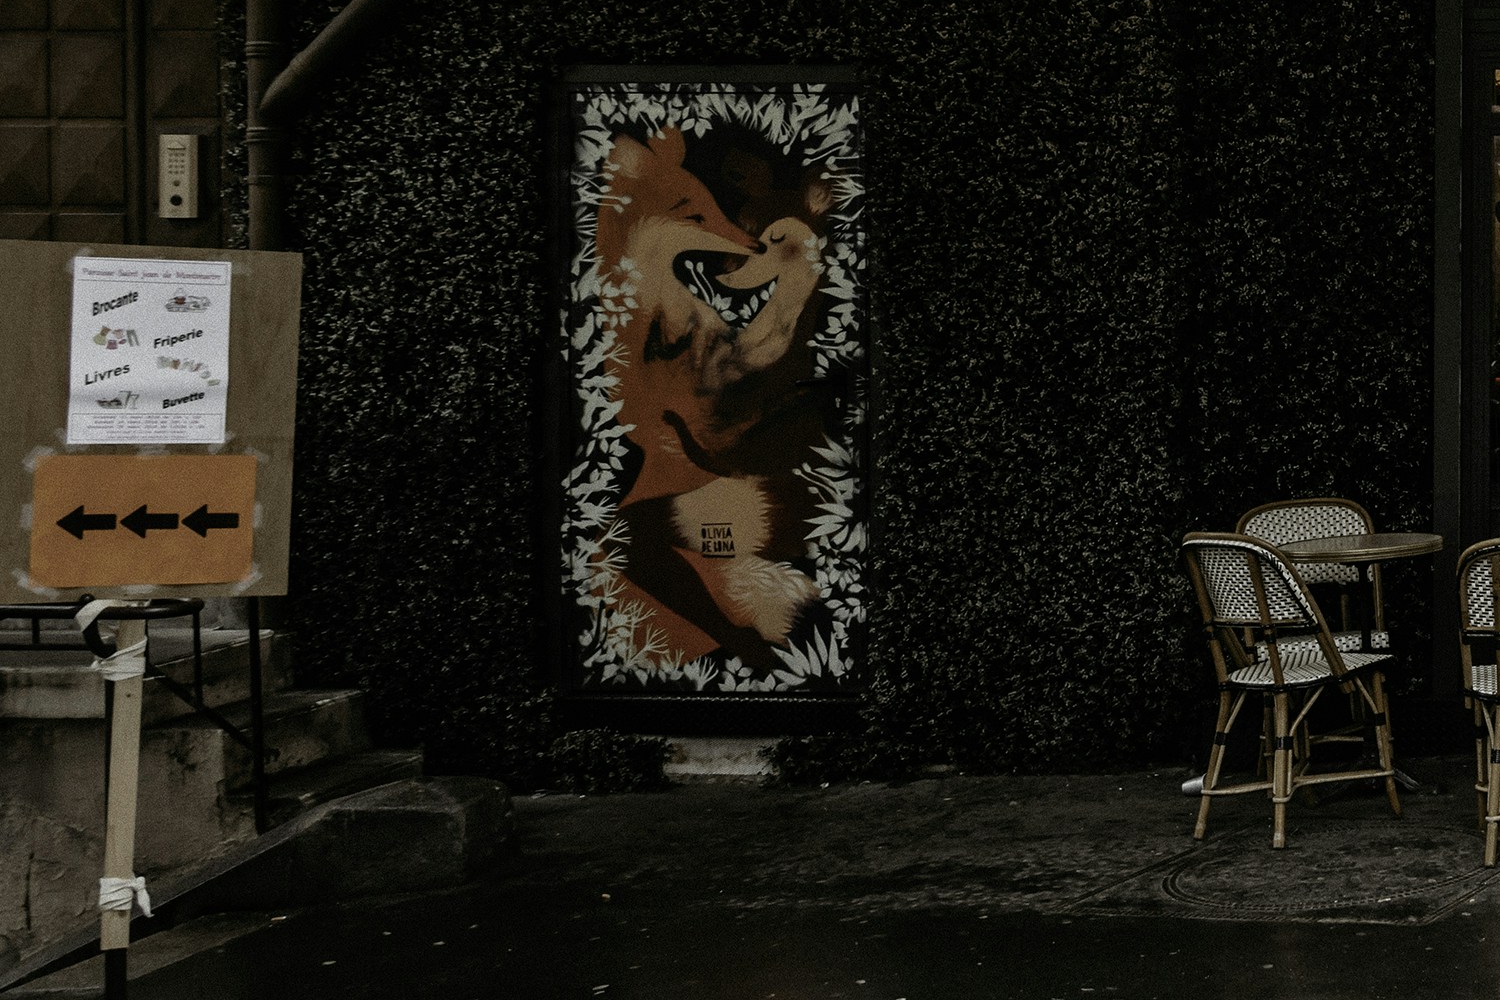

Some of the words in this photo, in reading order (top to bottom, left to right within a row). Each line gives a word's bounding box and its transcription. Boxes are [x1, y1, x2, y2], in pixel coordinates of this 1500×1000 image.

[92, 291, 139, 317] Brocante
[153, 328, 204, 349] Friperie
[85, 363, 130, 386] Livres
[162, 391, 205, 410] Buvette
[701, 527, 732, 539] OLIVIA
